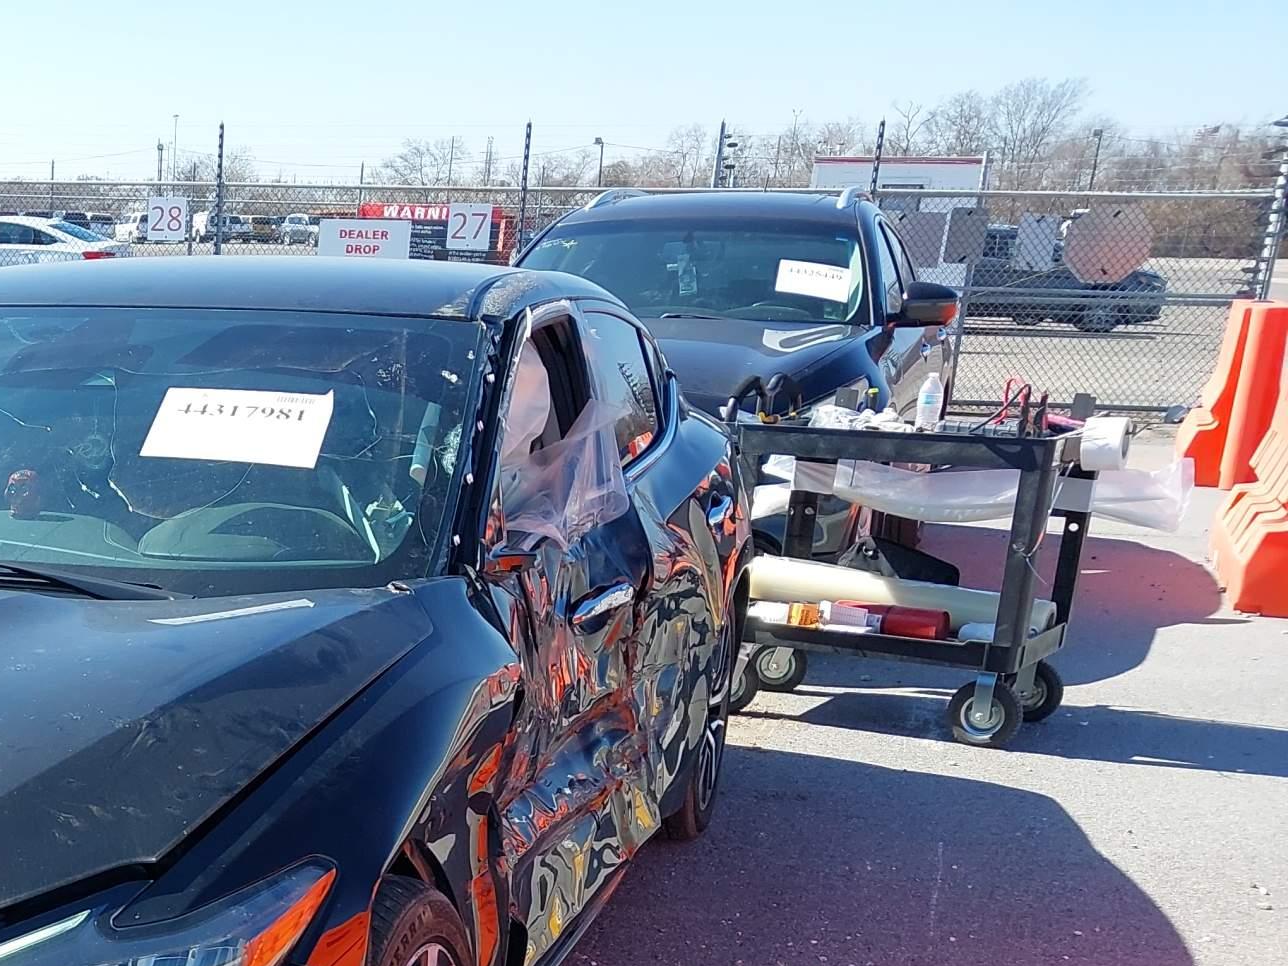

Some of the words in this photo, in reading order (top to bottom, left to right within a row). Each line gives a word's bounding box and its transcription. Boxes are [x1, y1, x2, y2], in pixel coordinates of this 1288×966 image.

[150, 205, 182, 232] 28
[382, 204, 448, 220] WARNI
[450, 207, 488, 240] 27
[339, 229, 389, 241] DEALER
[345, 244, 380, 255] DROP
[176, 402, 306, 422] 44317981
